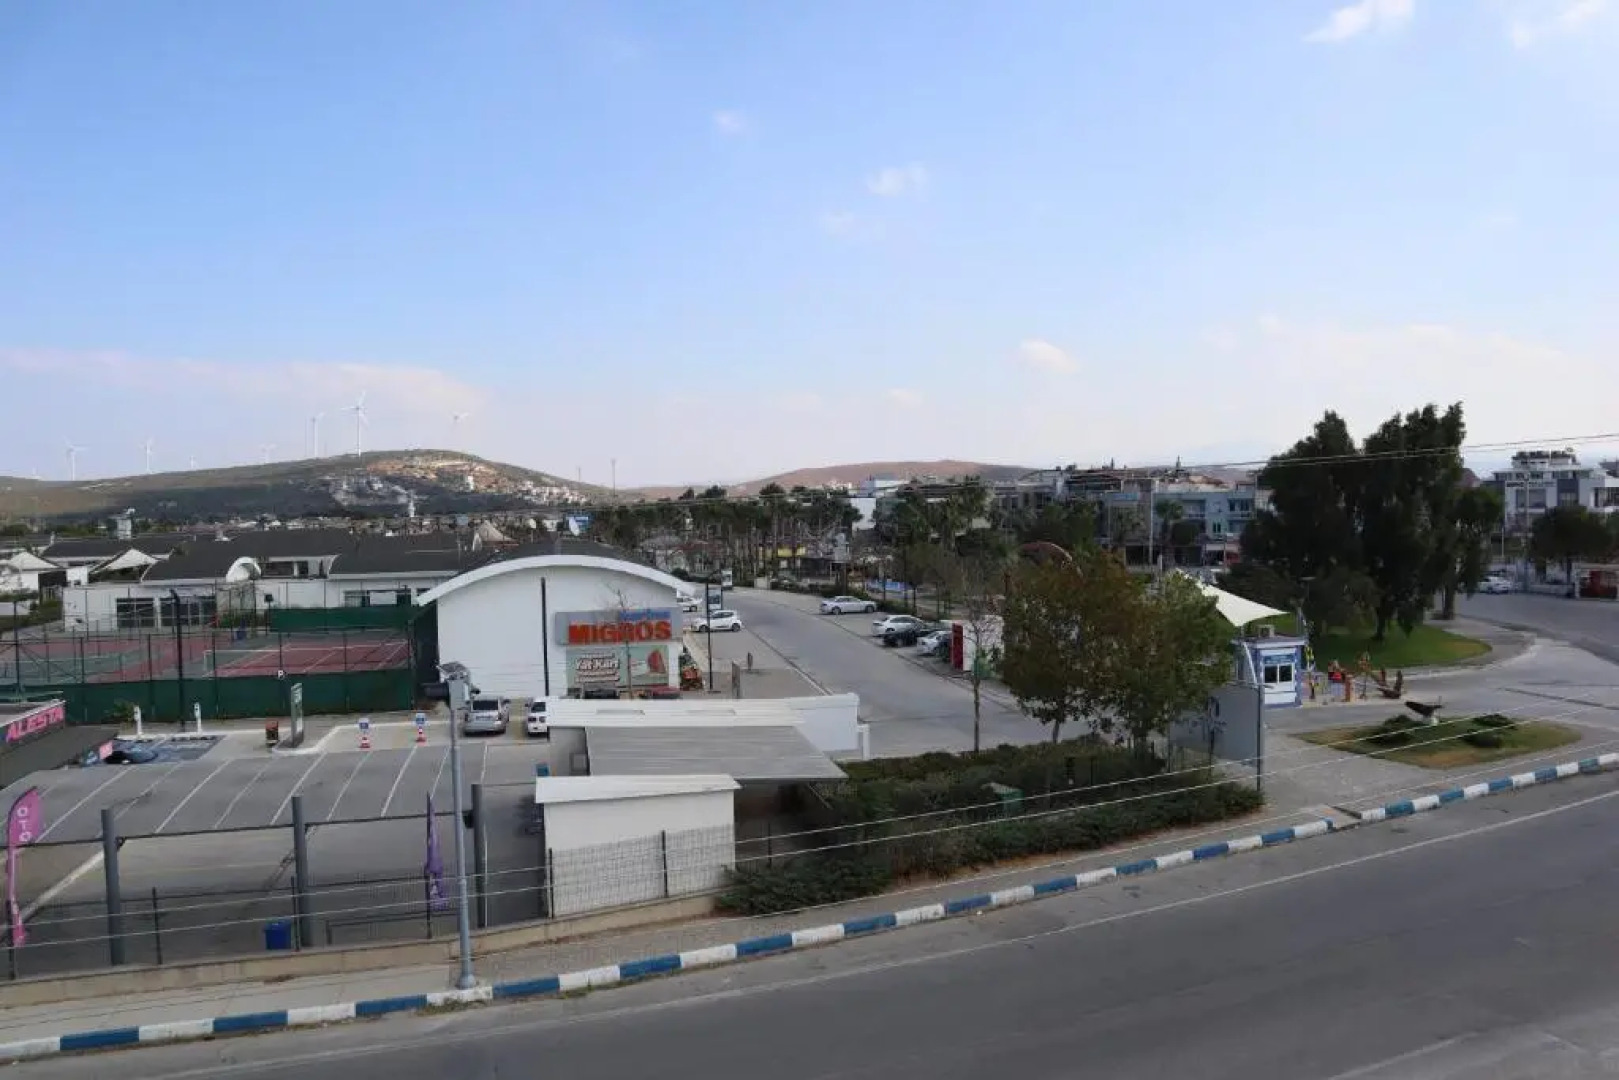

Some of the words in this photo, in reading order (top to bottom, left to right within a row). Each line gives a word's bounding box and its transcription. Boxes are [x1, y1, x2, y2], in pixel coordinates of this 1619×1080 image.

[569, 620, 672, 644] MIGROS
[6, 706, 65, 743] ALESTA
[17, 807, 31, 842] OTO
